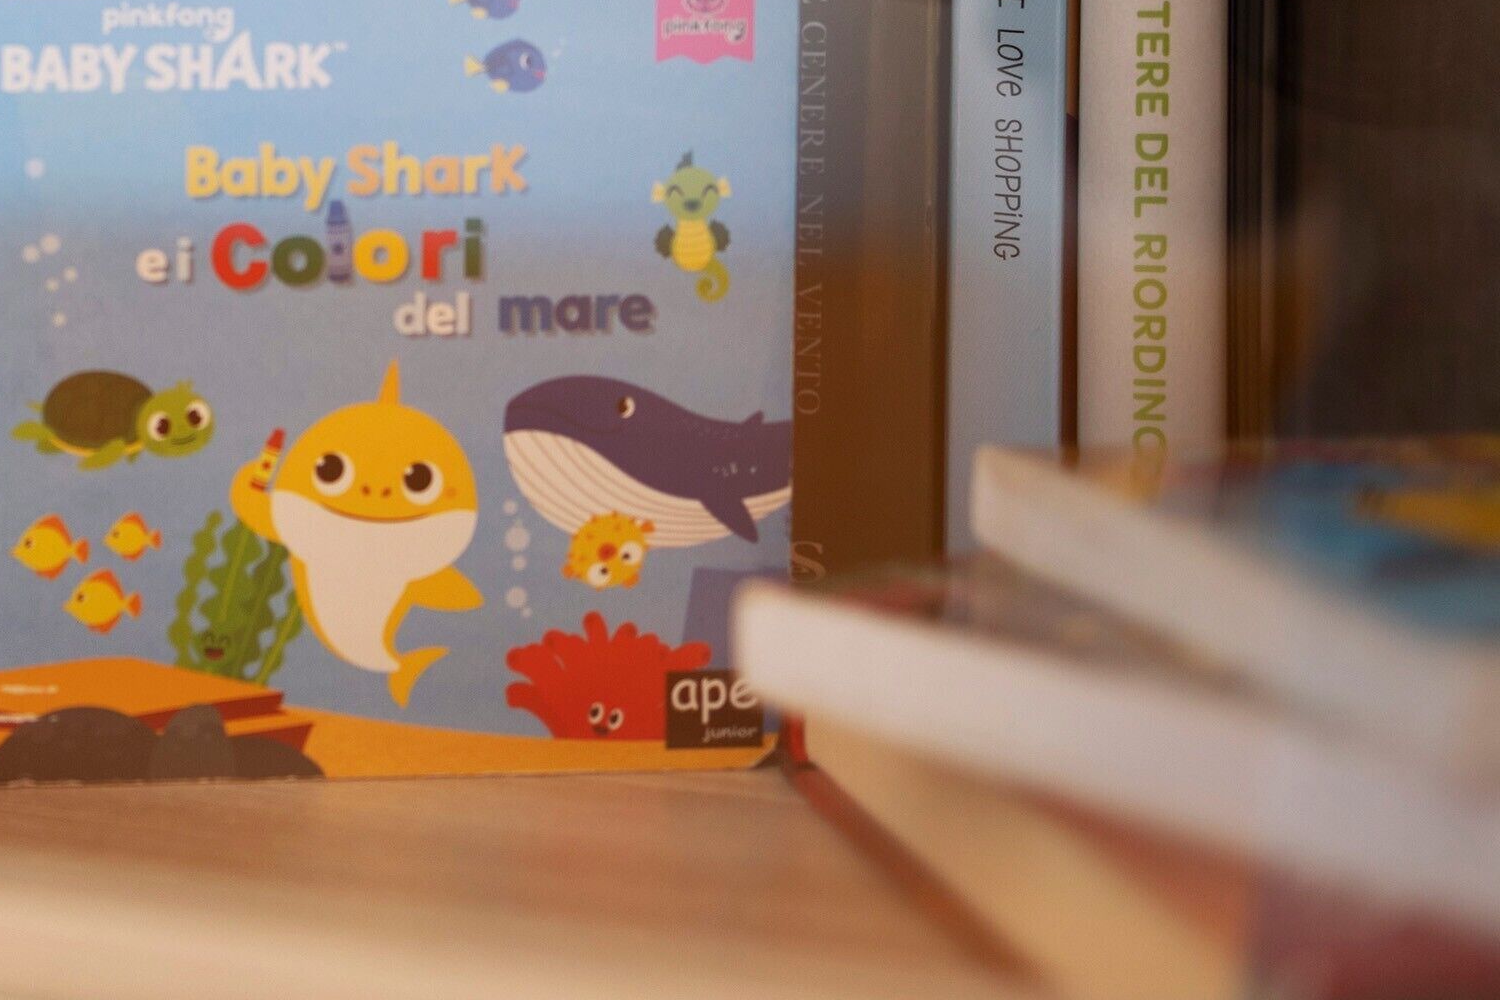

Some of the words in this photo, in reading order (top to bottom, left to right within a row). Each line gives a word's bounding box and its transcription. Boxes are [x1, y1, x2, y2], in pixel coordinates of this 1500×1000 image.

[102, 2, 235, 43] pinkfong
[0, 44, 138, 95] BABY
[799, 21, 828, 177] CENERE
[185, 142, 337, 213] Baby
[1133, 132, 1169, 219] DEL
[797, 192, 825, 267] NEL
[392, 289, 473, 337] del
[498, 292, 656, 336] mare
[796, 283, 823, 416] VENTO
[670, 677, 758, 725] ape
